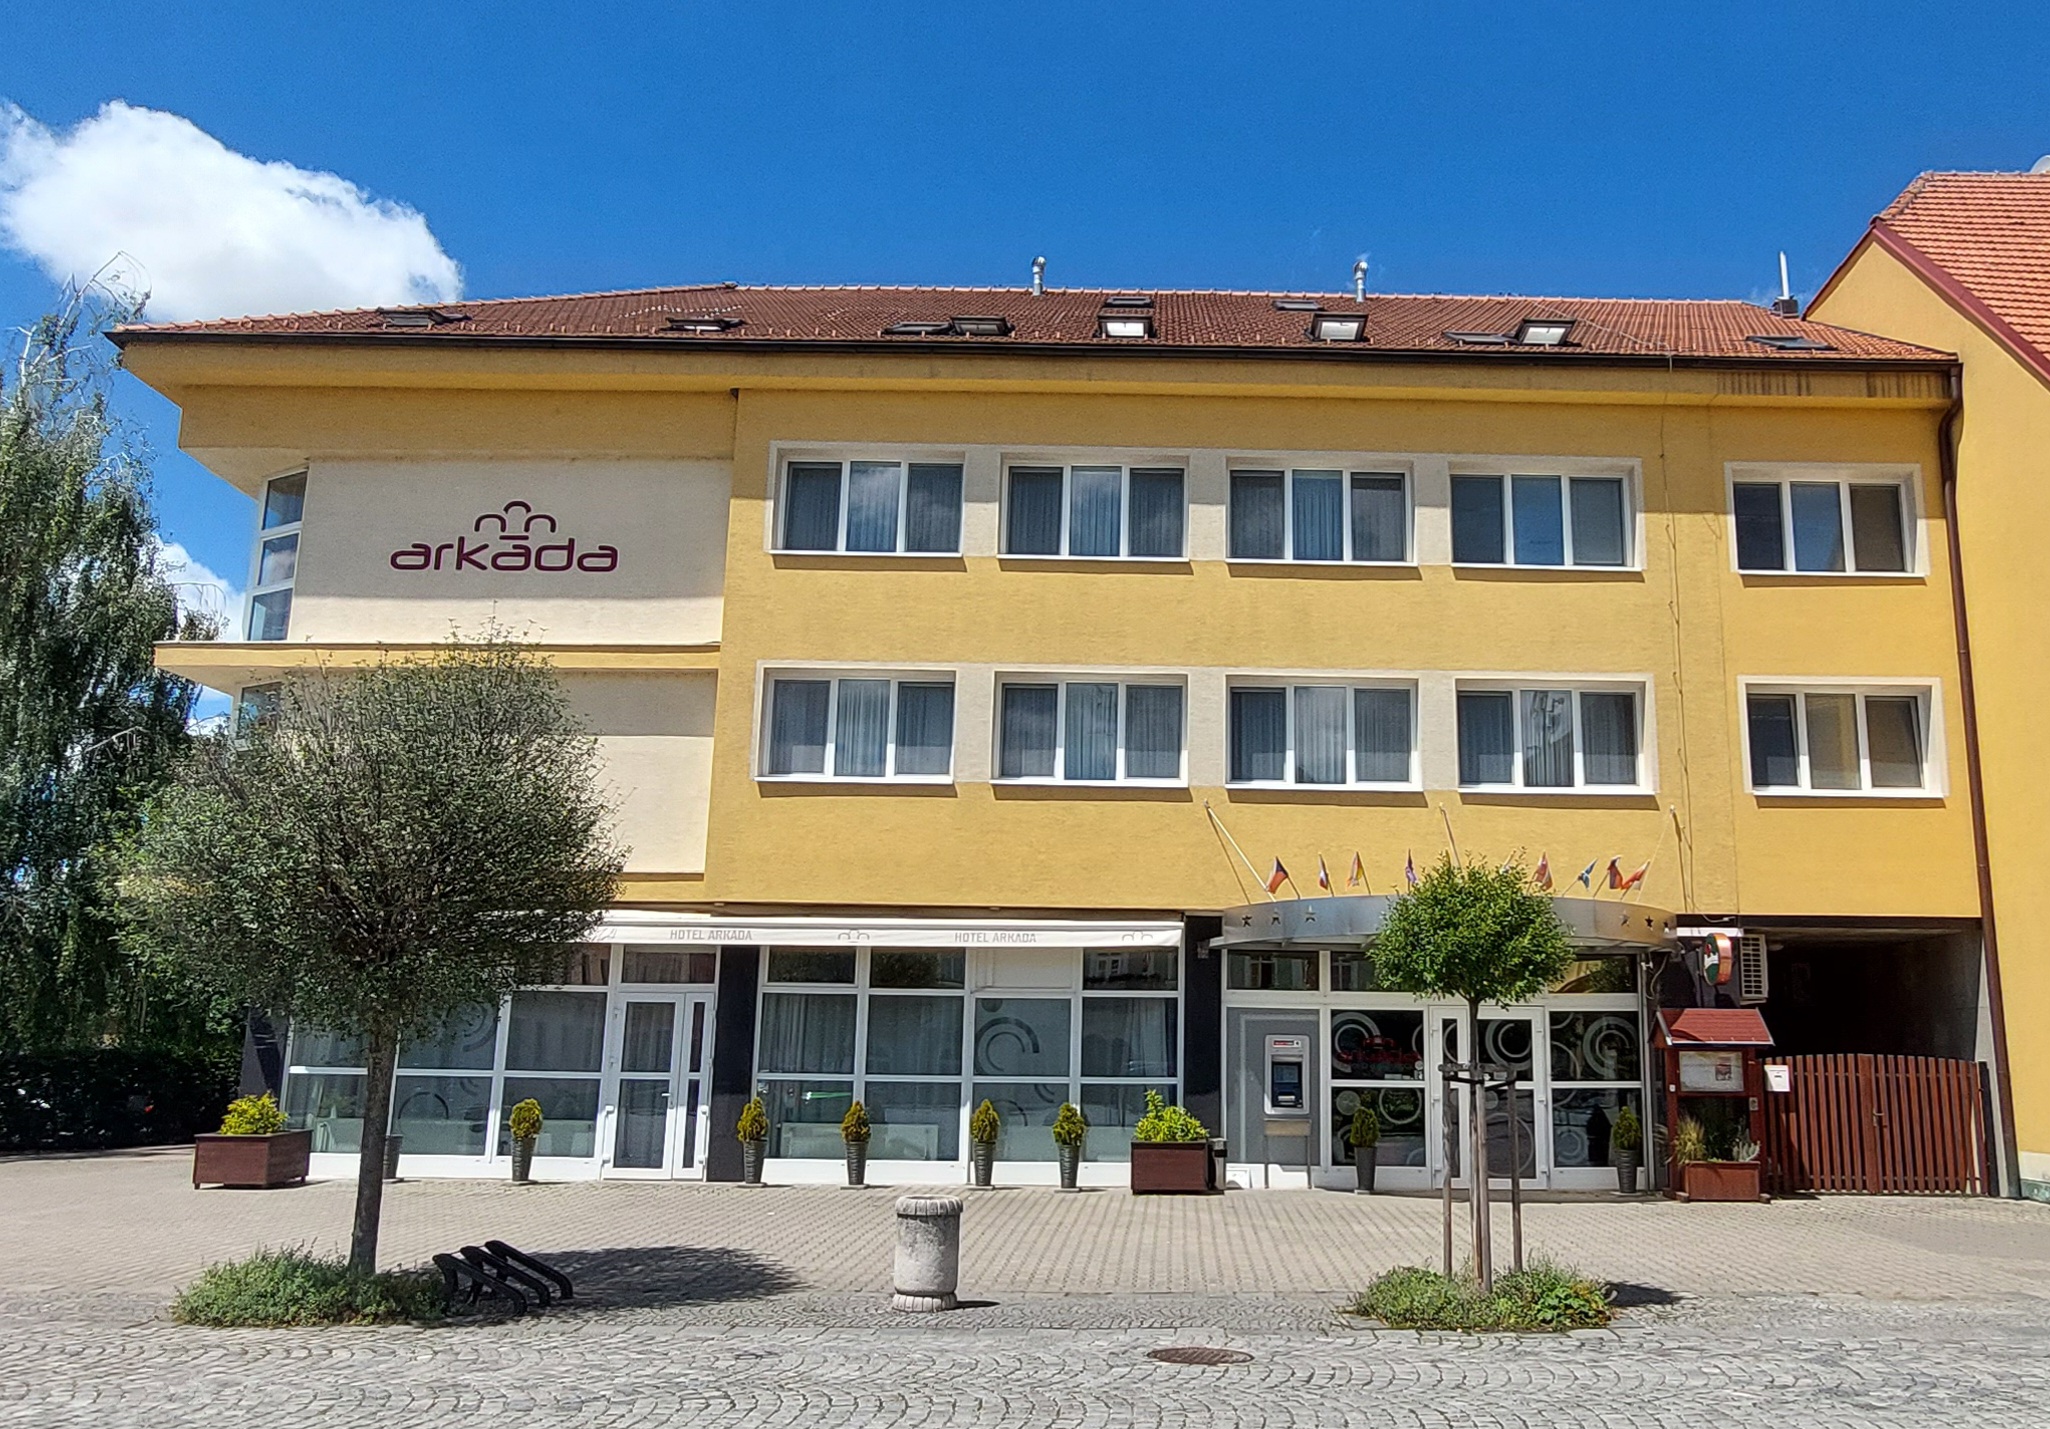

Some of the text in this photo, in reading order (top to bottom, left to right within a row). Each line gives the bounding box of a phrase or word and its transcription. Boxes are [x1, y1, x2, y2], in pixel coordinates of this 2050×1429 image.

[389, 535, 619, 573] arkada
[669, 929, 753, 941] HOTEL ARKADA
[954, 931, 1037, 943] HOTEL ARKADA
